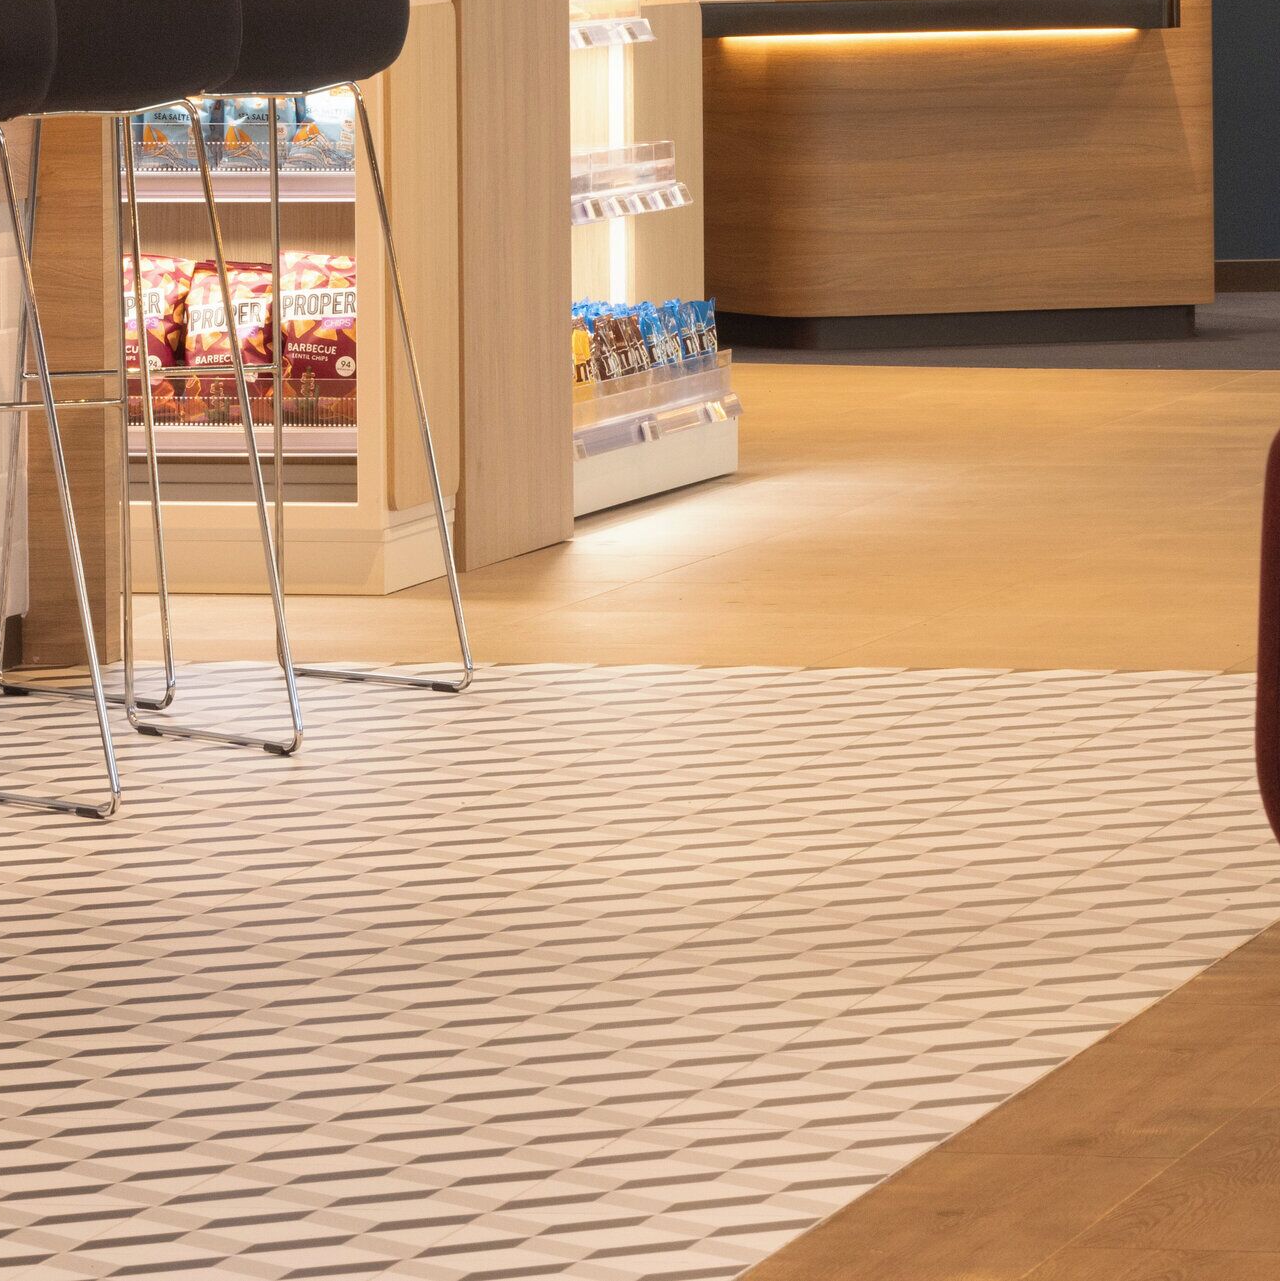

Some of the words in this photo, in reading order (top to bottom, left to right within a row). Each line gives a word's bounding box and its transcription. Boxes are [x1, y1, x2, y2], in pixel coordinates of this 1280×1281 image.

[153, 112, 166, 120] SEA
[282, 291, 356, 318] PROPER
[323, 318, 351, 328] CHIPS
[287, 342, 337, 355] BARBECUE
[291, 352, 310, 360] LENTIL
[311, 354, 328, 362] CHIPS
[340, 360, 351, 368] 94
